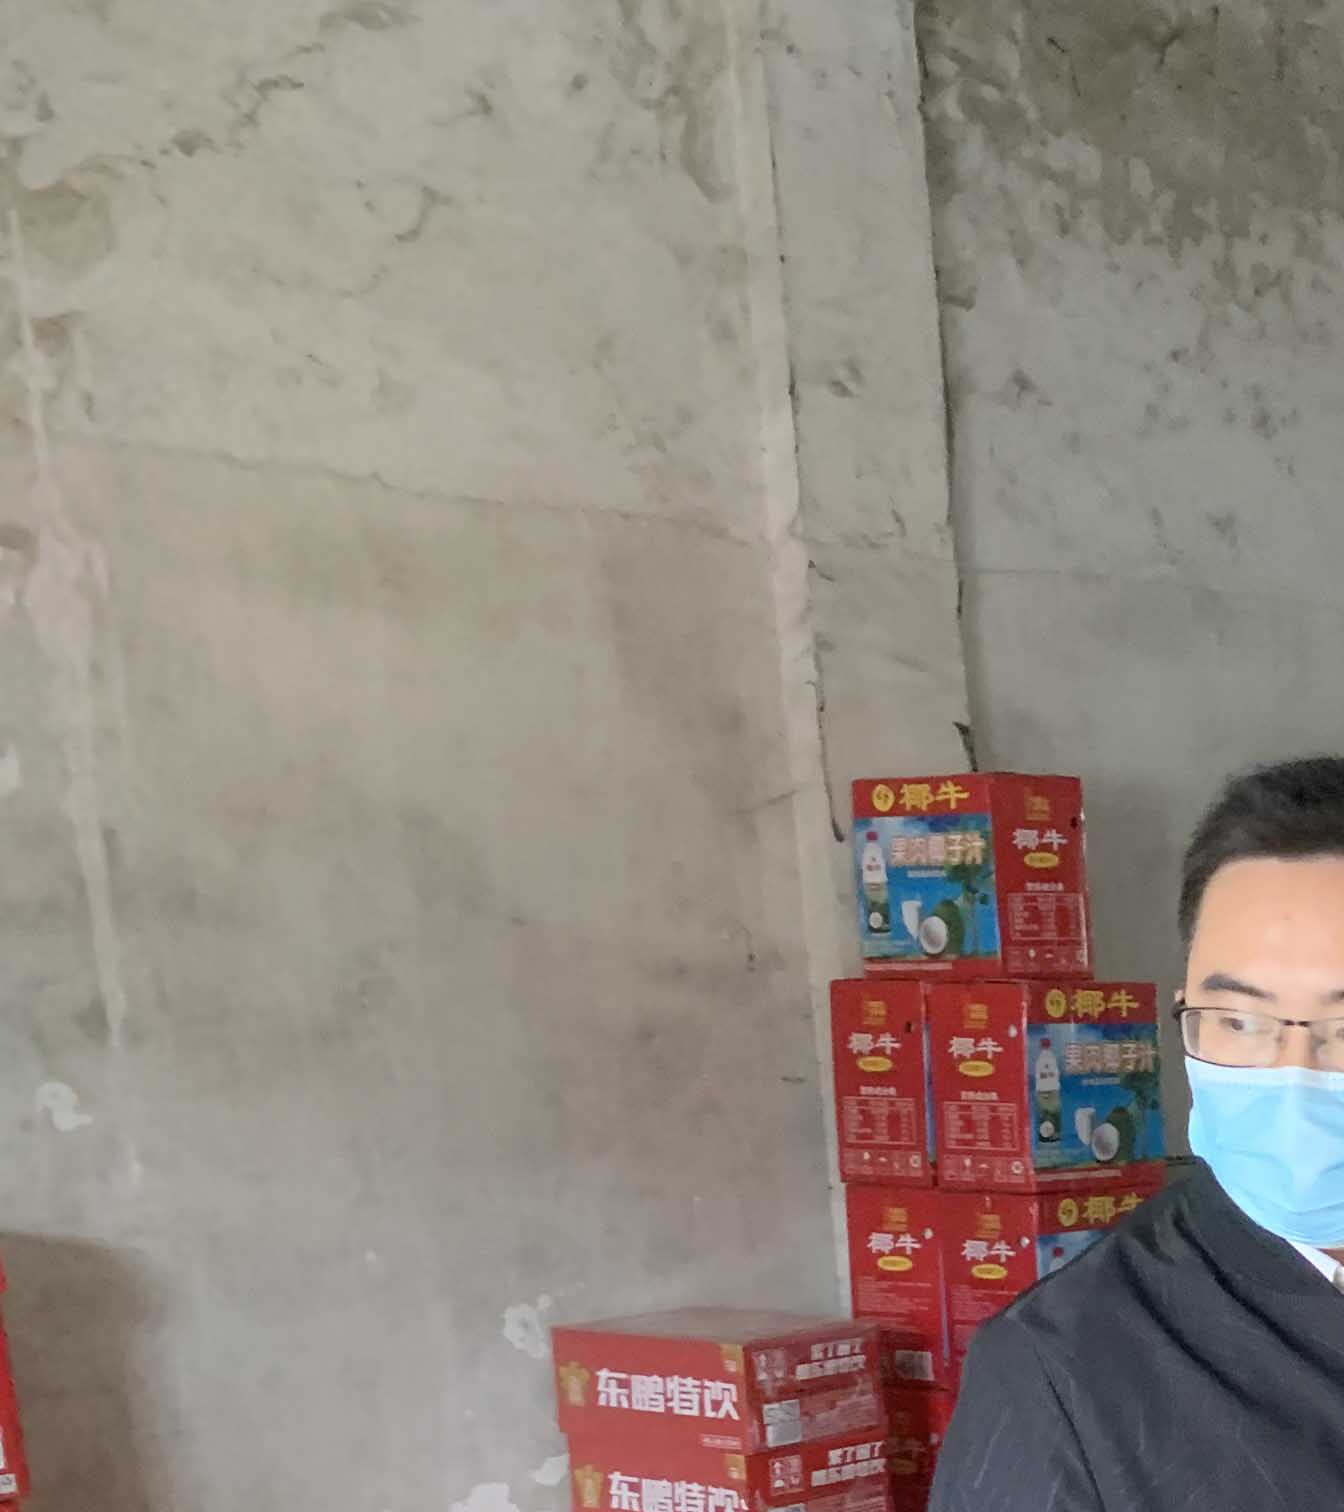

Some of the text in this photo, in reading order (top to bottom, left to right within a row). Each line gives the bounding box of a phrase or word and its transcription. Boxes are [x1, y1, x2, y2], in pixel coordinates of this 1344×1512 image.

[899, 781, 969, 811] 椰牛
[1012, 829, 1068, 851] 椰牛
[1072, 989, 1139, 1018] 椰牛
[848, 1033, 900, 1055] 椰牛
[949, 1037, 1004, 1060] 椰牛
[867, 1232, 921, 1255] 椰牛
[961, 1239, 1016, 1263] 椰牛
[595, 1366, 740, 1421] 东鹏特饮
